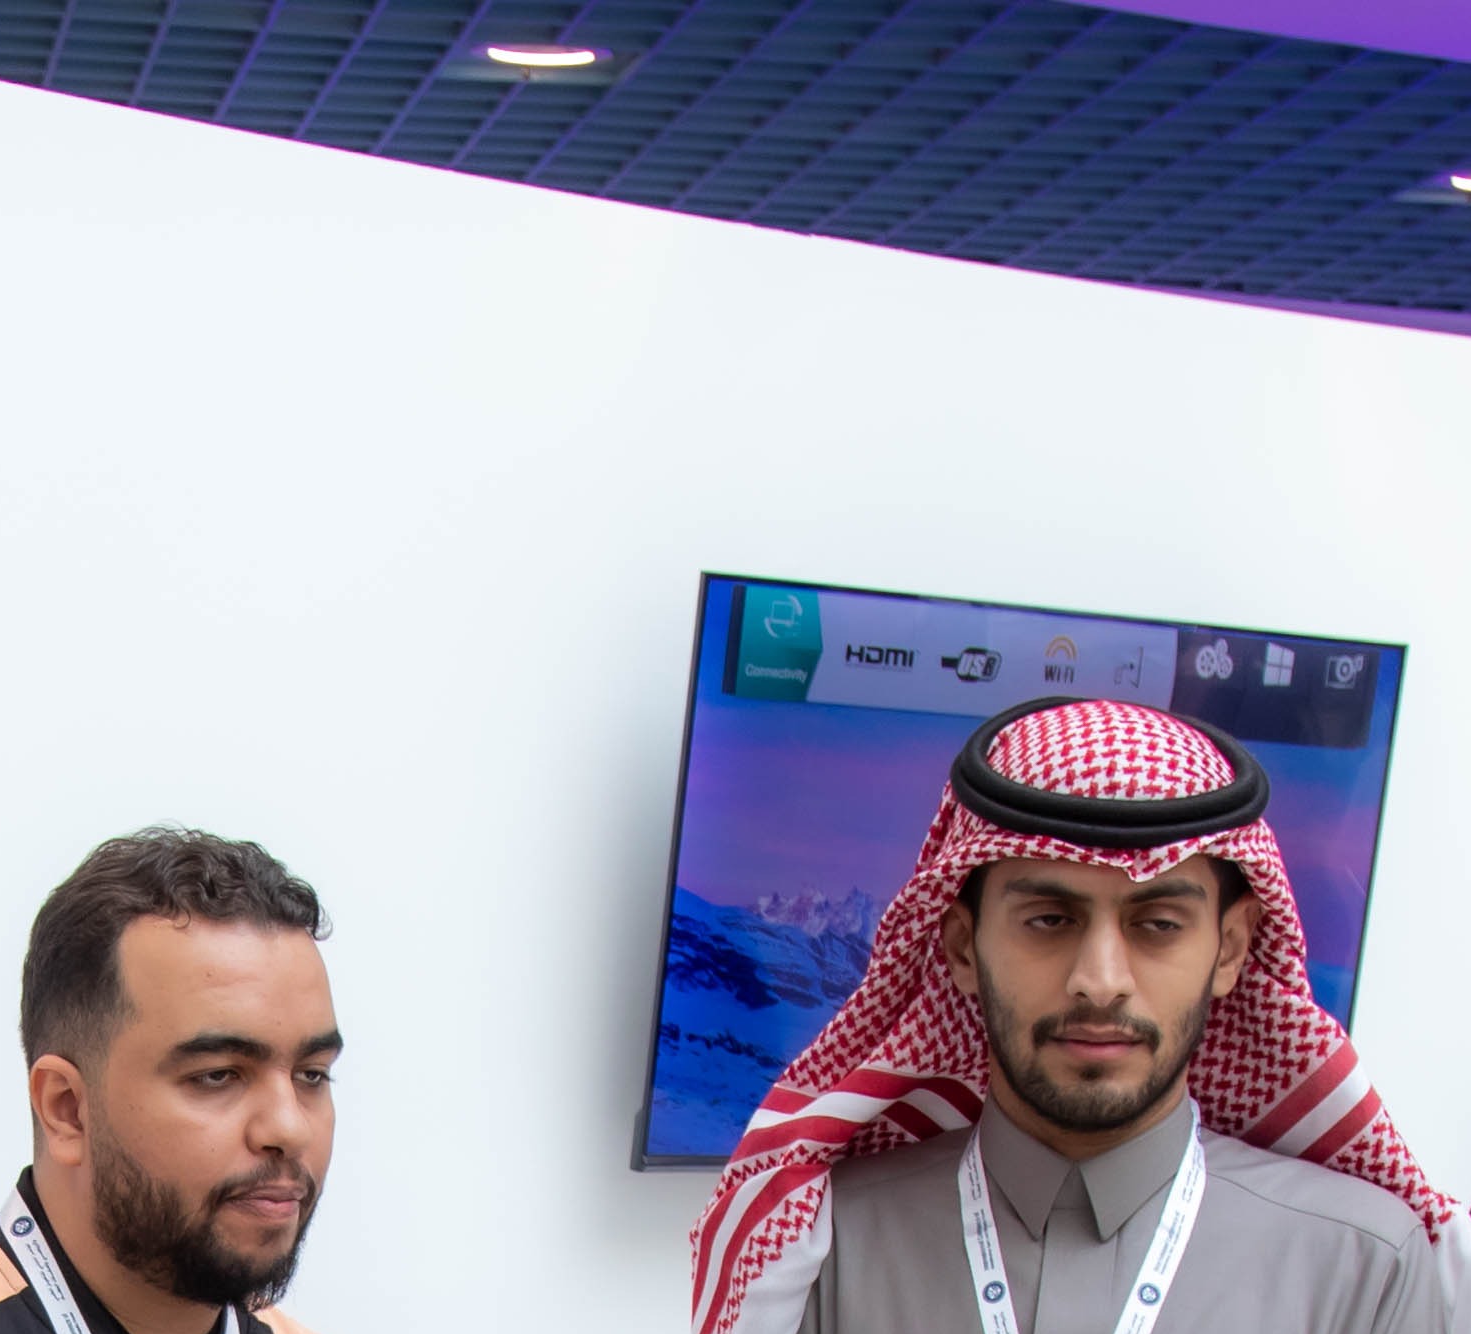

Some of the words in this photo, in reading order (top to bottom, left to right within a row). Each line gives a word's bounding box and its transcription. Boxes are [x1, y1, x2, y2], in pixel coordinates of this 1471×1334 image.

[844, 643, 915, 668] HDMI
[957, 649, 1001, 679] USB
[744, 662, 808, 683] Connectivity
